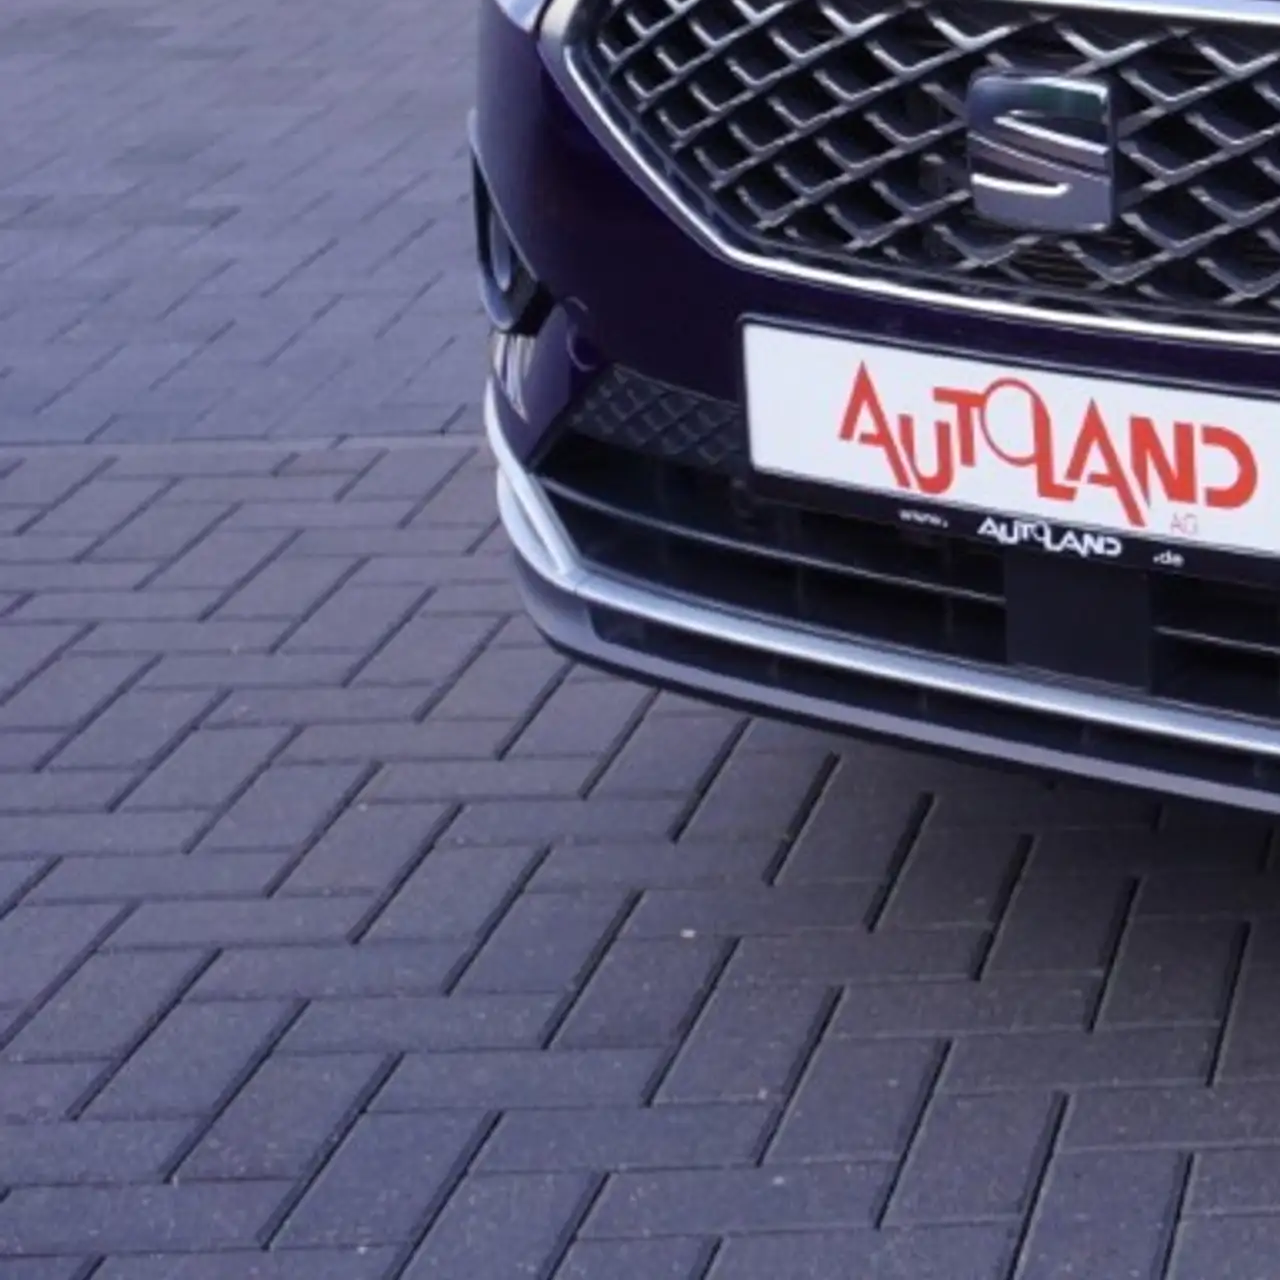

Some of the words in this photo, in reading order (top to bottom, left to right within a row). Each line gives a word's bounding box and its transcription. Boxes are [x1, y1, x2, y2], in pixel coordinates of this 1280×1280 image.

[839, 361, 1258, 526] AUTOLAND
[976, 516, 1123, 558] AUTOLAND
[1170, 511, 1199, 536] AG
